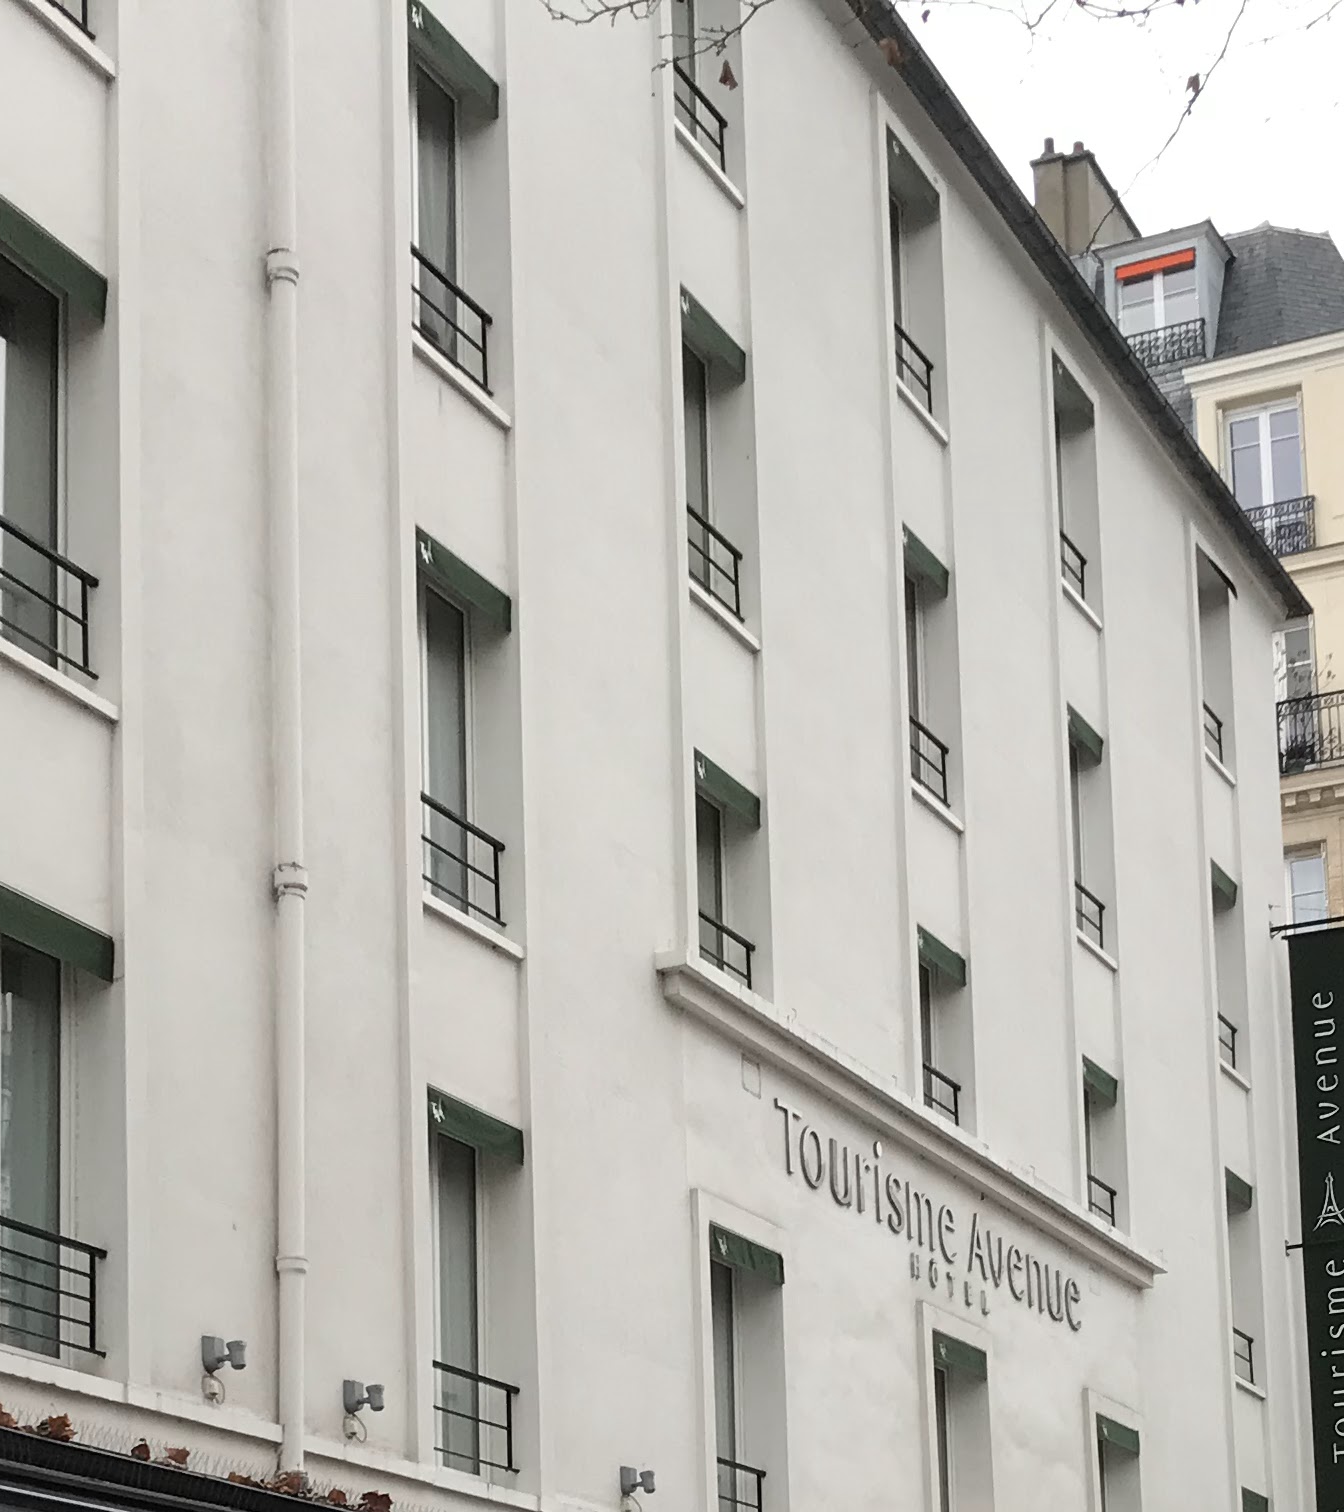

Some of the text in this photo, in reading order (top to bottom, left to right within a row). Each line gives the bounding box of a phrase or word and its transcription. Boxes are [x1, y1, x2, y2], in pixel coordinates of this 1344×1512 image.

[1312, 990, 1341, 1145] Avenue
[773, 1098, 1082, 1333] Tourisme Avenue
